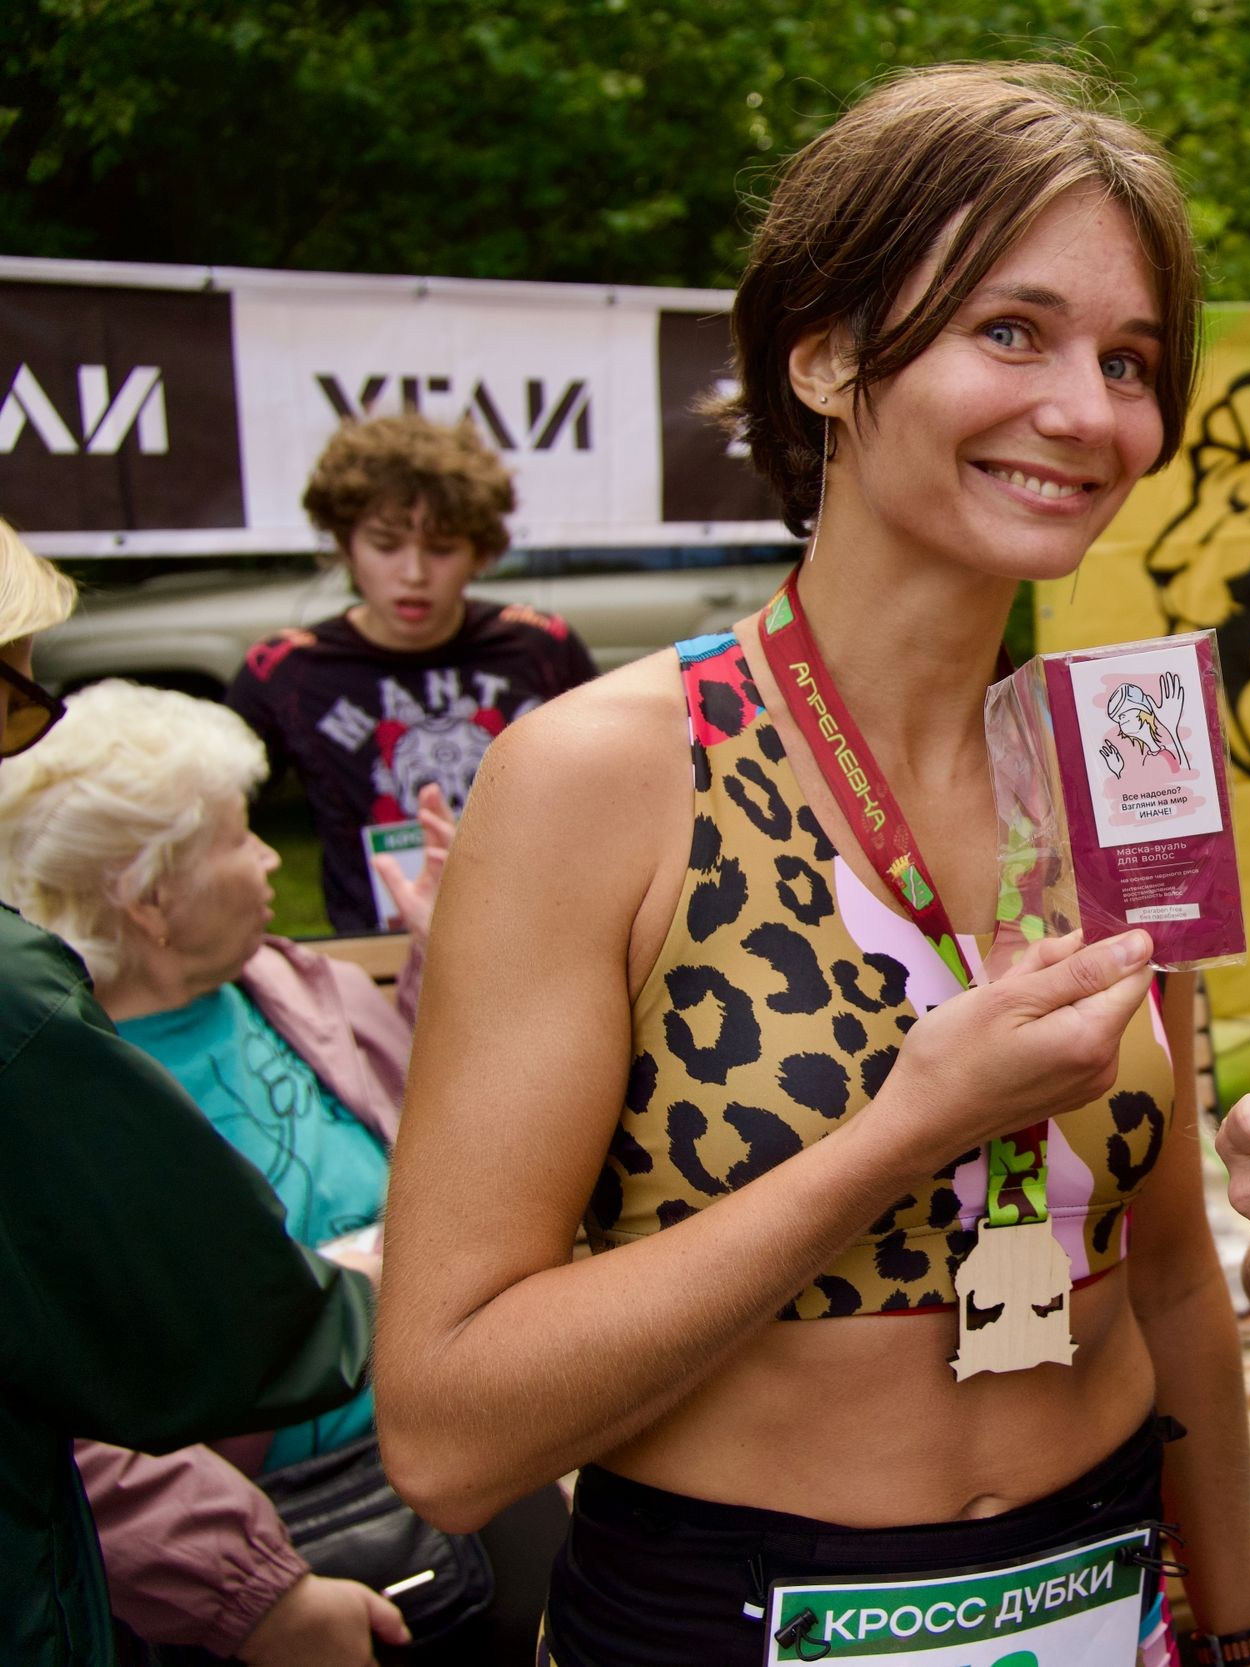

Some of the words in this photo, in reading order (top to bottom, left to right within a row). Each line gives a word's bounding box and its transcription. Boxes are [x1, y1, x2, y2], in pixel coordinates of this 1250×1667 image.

[789, 661, 887, 832] АПРЕЛЕВКА
[1122, 793, 1139, 802] Все
[1140, 786, 1182, 800] надоело?
[1121, 799, 1156, 811] Взгляни
[1157, 799, 1170, 807] на
[1170, 796, 1188, 805] мир
[1139, 808, 1172, 819] ИНАЧЕ!
[1116, 843, 1187, 857] маска-вуаль
[1117, 856, 1138, 866] для
[1141, 852, 1175, 864] волос
[824, 1597, 987, 1641] КРОСС
[994, 1561, 1115, 1629] ДУБКИ
